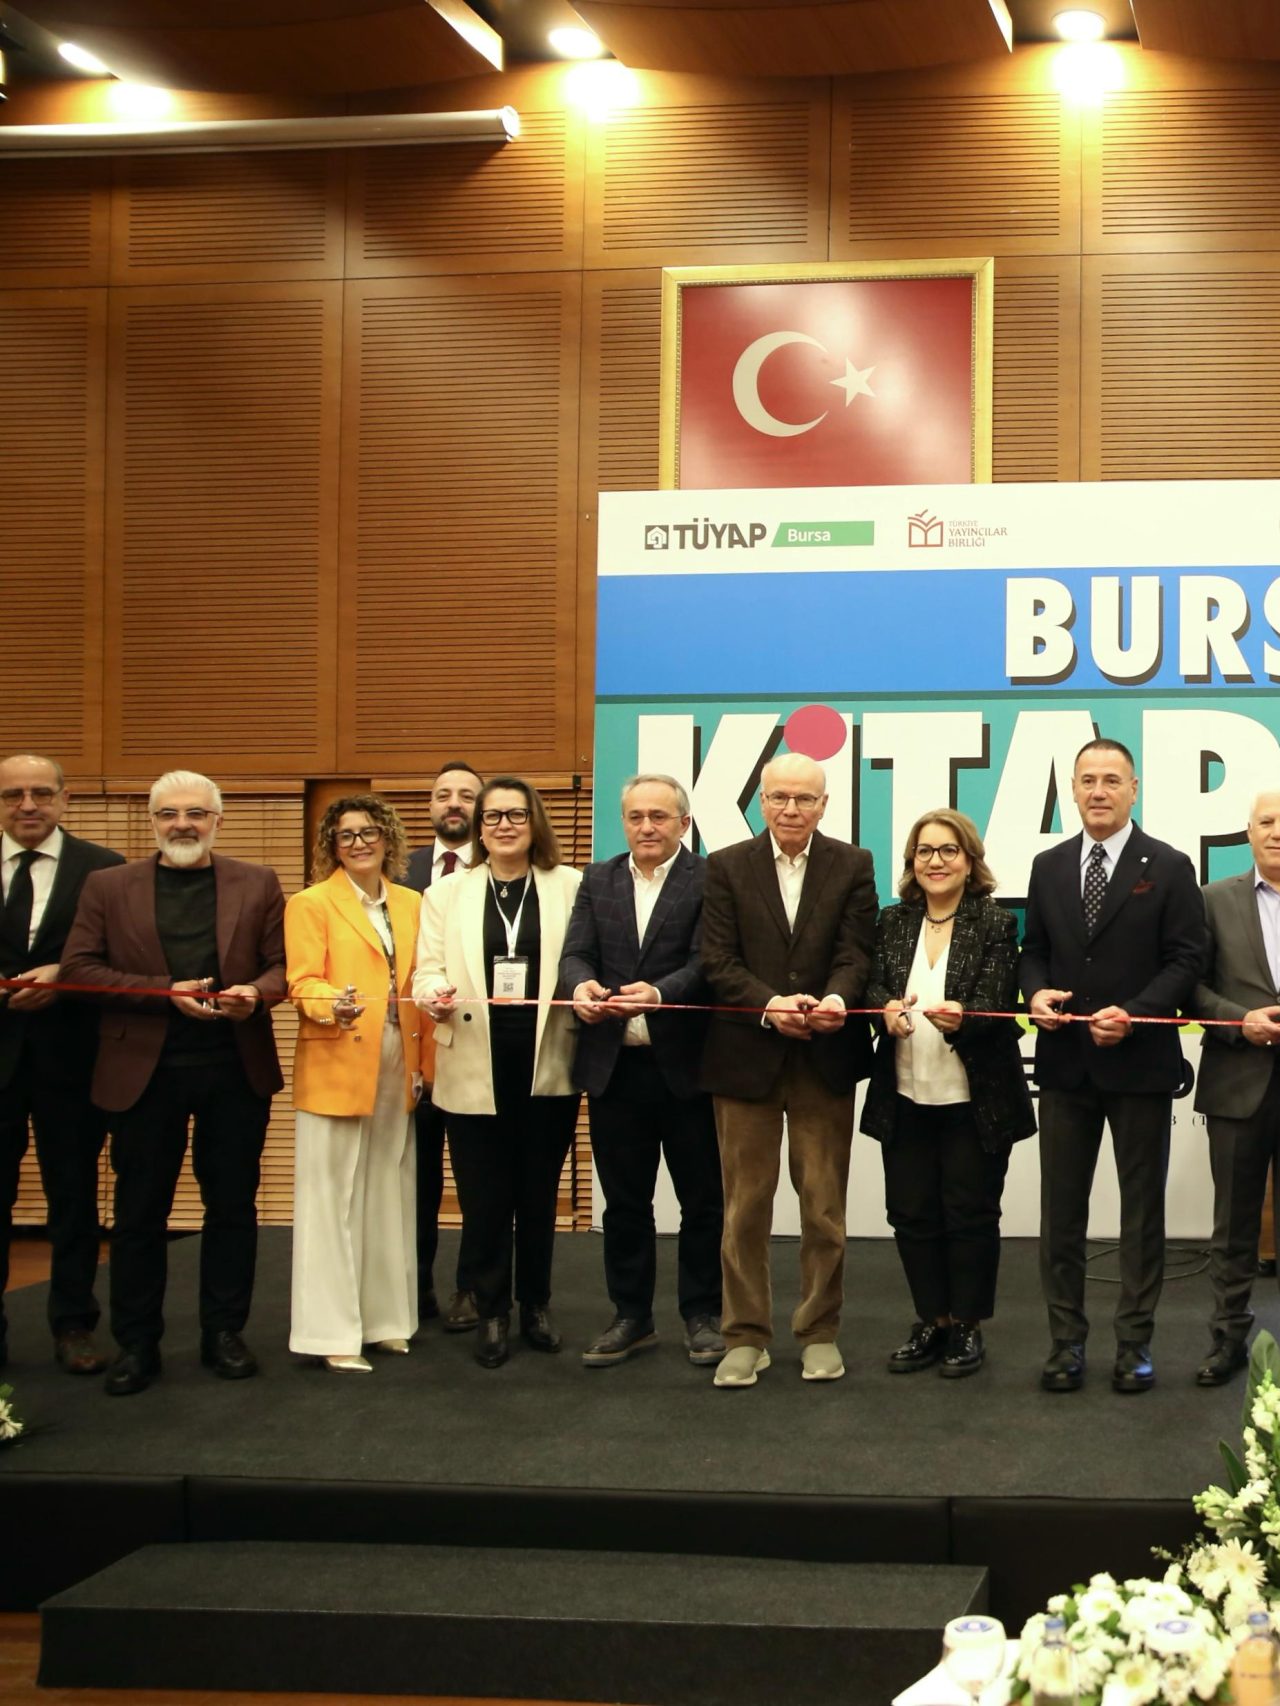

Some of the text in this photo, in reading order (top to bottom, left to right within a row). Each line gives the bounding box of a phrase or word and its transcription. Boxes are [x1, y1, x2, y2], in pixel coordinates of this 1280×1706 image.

[673, 517, 767, 550] TÜYAP
[787, 527, 831, 543] Bursa
[948, 527, 1008, 537] YAYINCILAR
